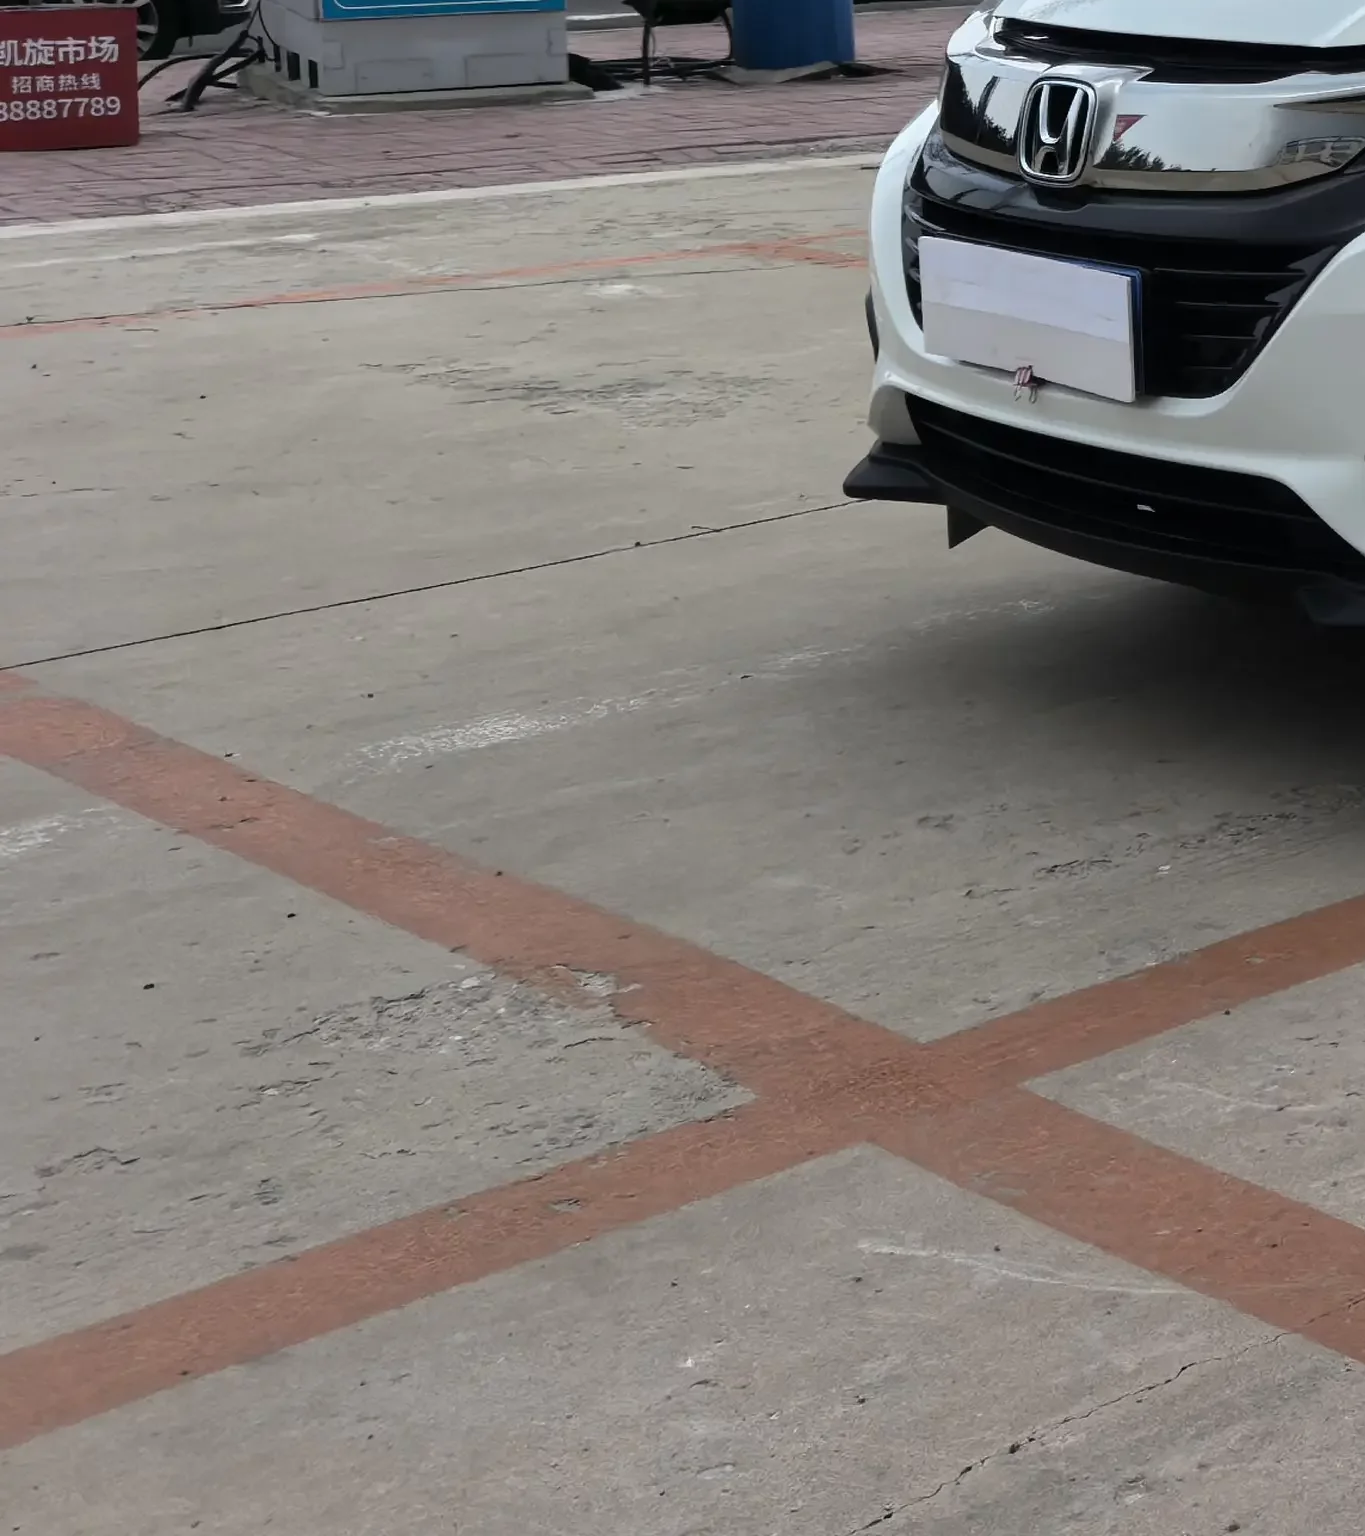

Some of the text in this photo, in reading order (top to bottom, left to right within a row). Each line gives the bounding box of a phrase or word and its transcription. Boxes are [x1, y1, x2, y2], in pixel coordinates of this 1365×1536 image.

[0, 35, 120, 67] 凯旋市场
[11, 72, 102, 95] 招商热线
